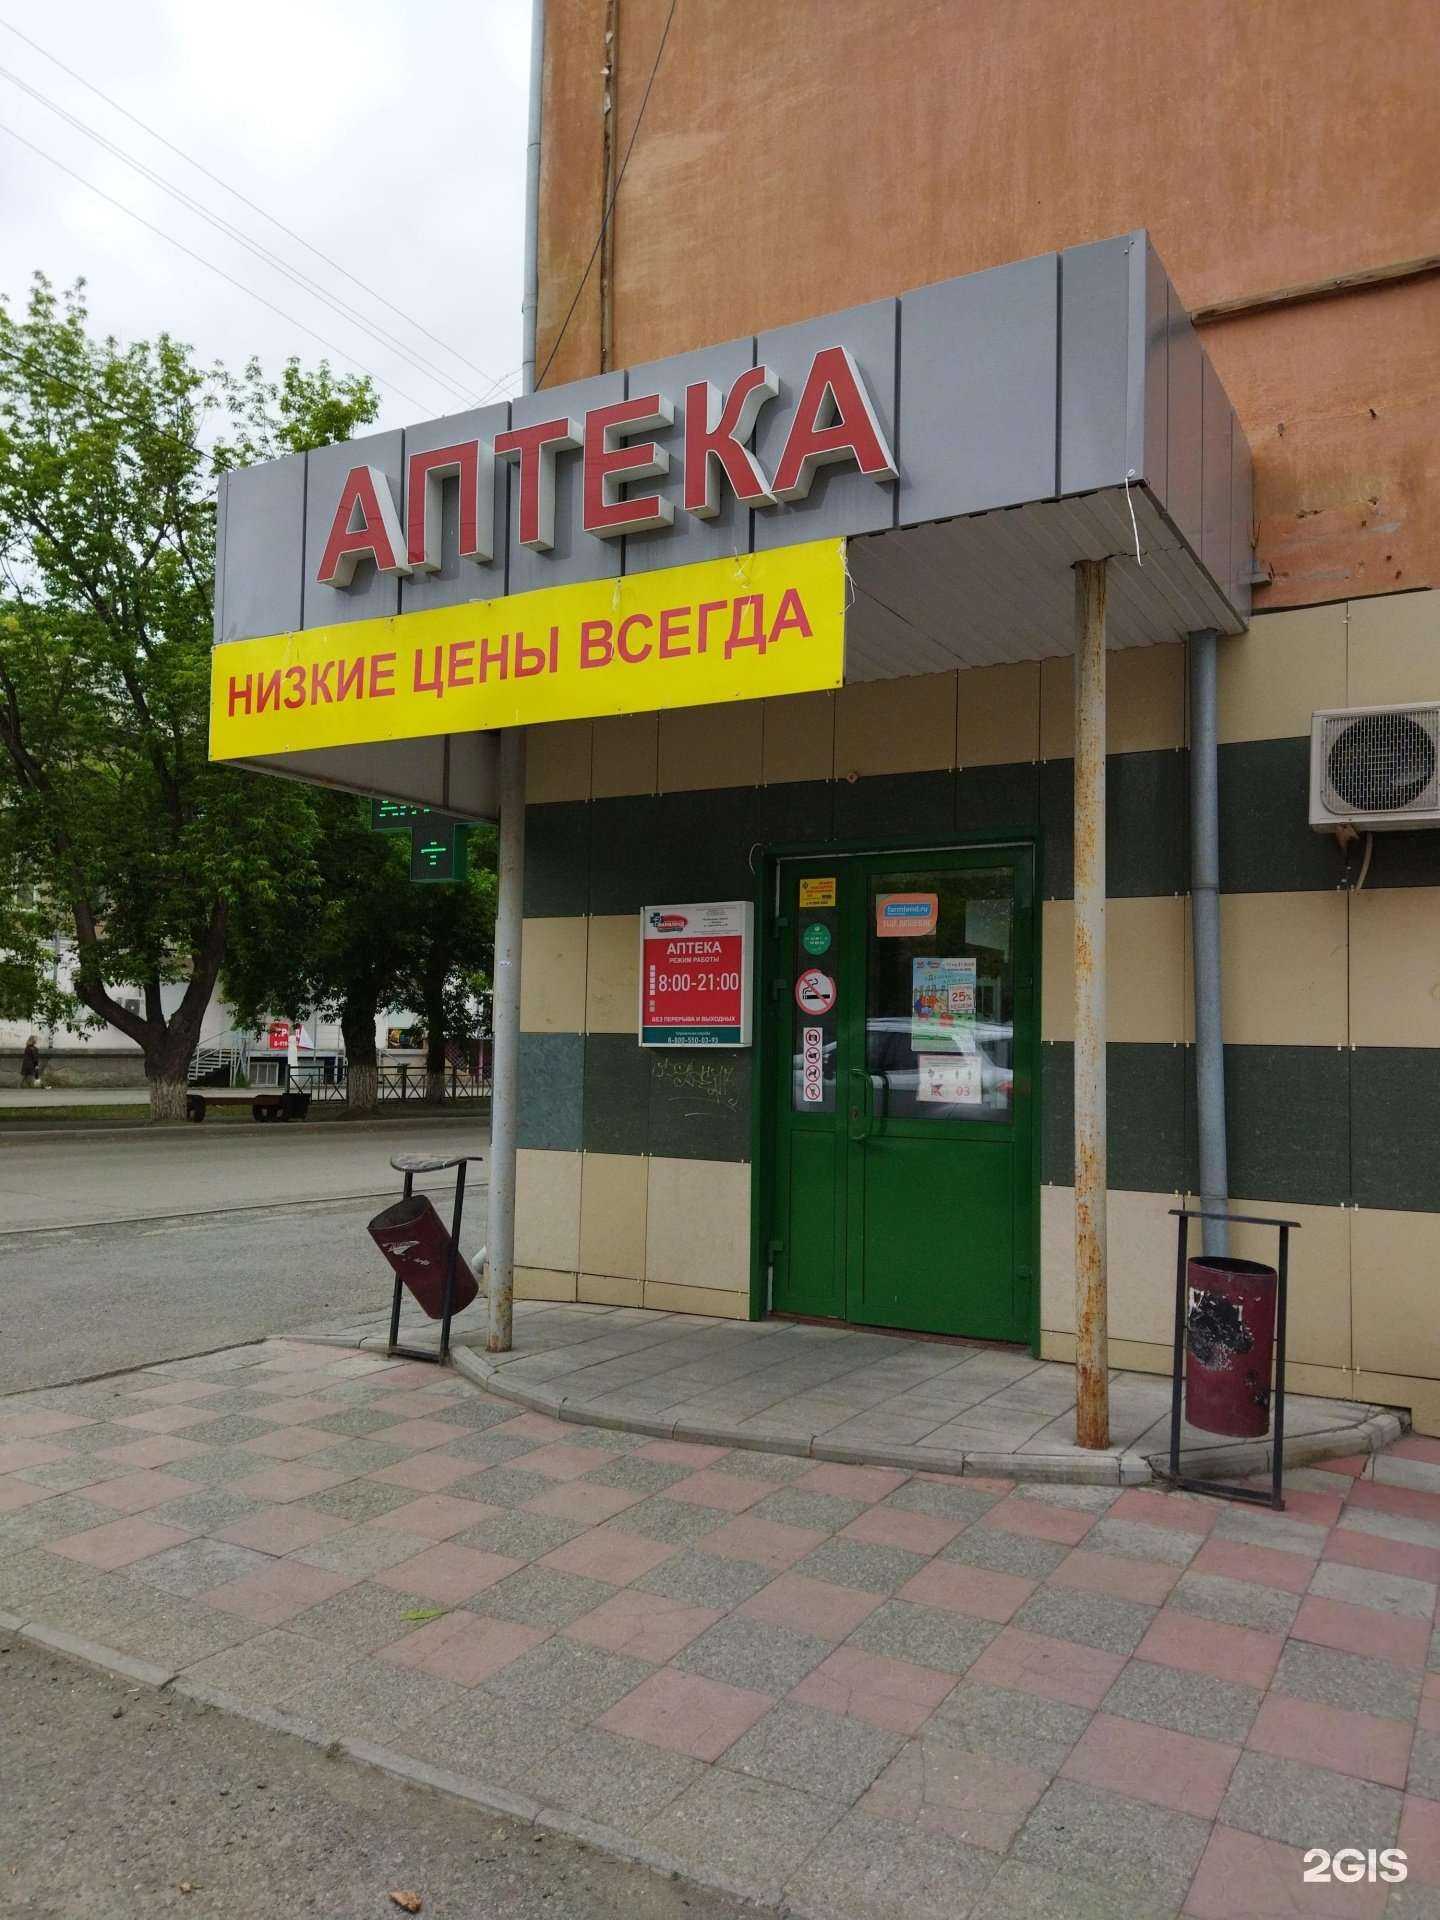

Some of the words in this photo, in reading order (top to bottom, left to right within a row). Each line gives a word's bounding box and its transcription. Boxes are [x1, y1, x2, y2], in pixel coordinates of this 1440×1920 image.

[317, 346, 899, 587] АПТЕКА
[227, 651, 396, 718] НИЗКИЕ
[412, 626, 559, 698] ЦЕНЫ
[579, 587, 814, 670] ВСЕГДА
[666, 941, 722, 955] АПТЕКА
[658, 973, 739, 992] 8:00-21:00
[952, 991, 972, 1002] 25%
